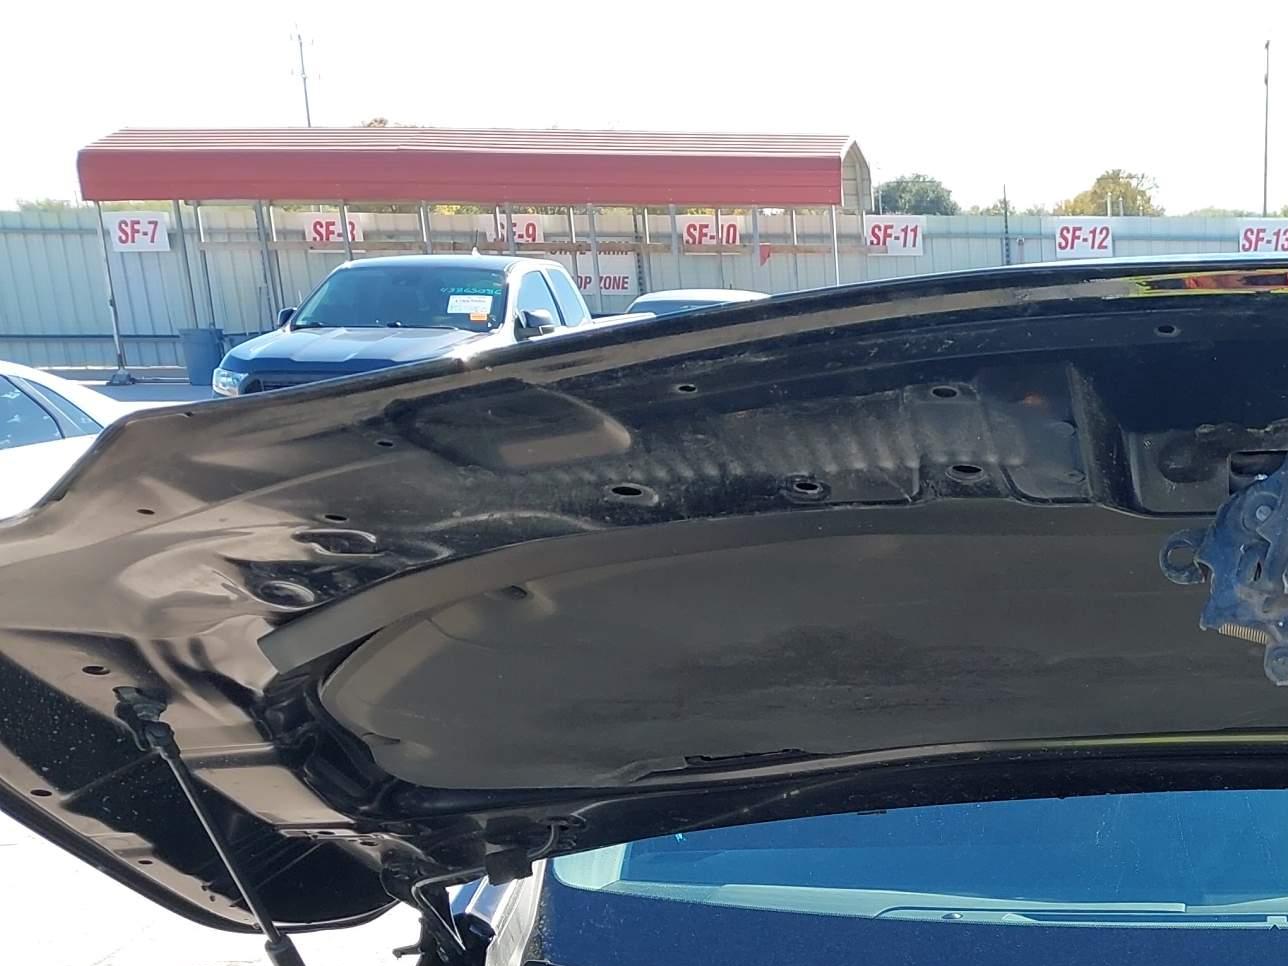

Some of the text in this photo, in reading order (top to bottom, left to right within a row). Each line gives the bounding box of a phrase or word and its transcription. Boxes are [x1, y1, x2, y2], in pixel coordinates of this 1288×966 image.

[118, 219, 159, 244] SF-7
[870, 224, 918, 248] SF-11
[1058, 226, 1110, 250] SF-12
[599, 275, 629, 290] ZONE
